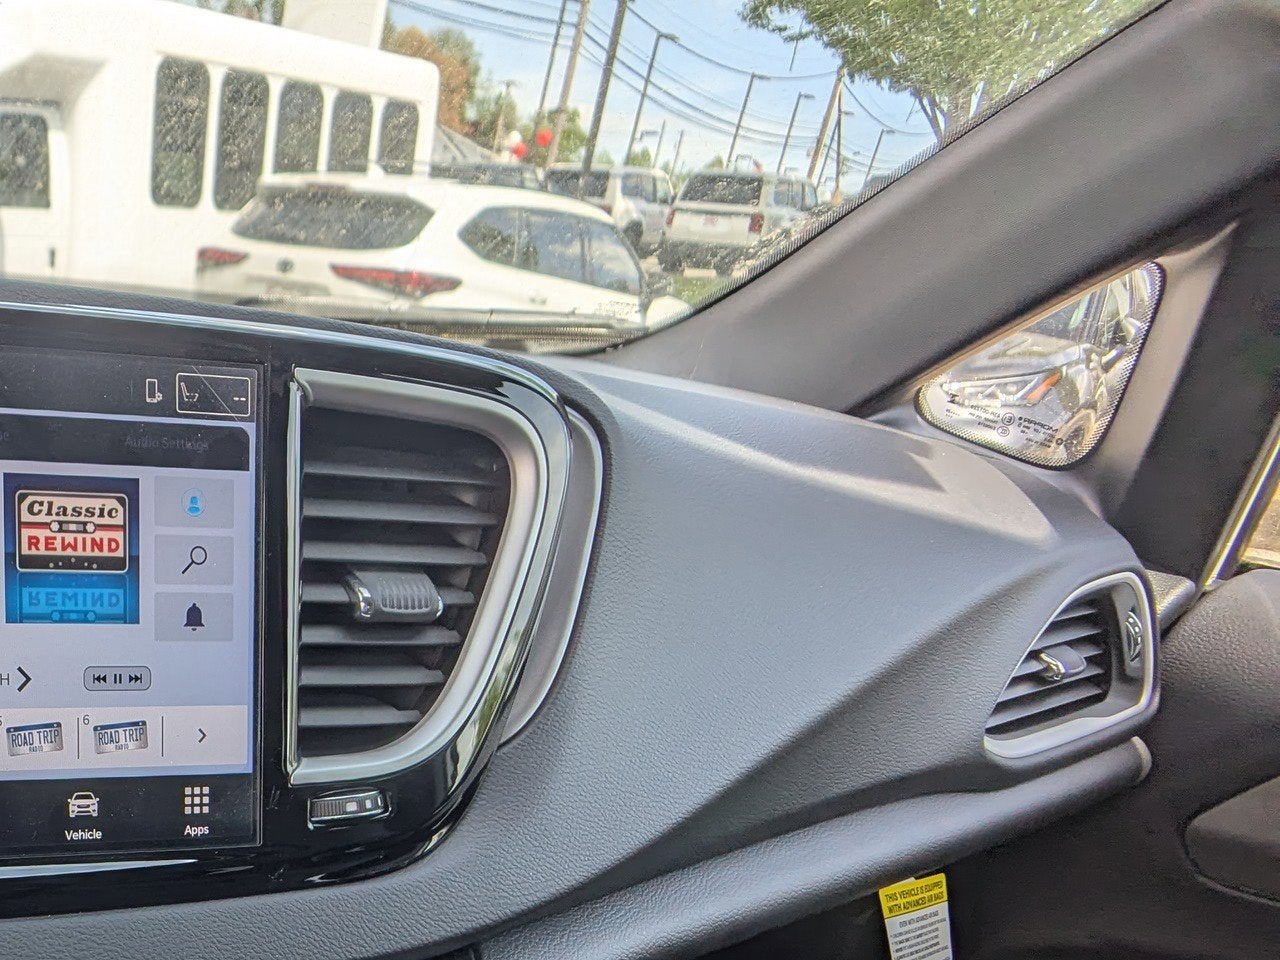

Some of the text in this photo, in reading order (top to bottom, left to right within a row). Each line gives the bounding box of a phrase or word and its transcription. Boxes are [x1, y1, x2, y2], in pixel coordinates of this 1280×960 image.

[26, 499, 120, 519] Classic
[26, 535, 121, 554] REWIND
[82, 714, 90, 725] 6
[11, 729, 60, 748] ROAD TRIP
[97, 727, 145, 746] ROAD TRIP
[64, 828, 103, 842] Vehicle
[183, 824, 210, 837] Apps
[885, 892, 898, 903] THIS
[899, 887, 919, 900] VEHICLE
[924, 880, 944, 893] EQUIPPED
[887, 903, 902, 915] WITH
[903, 895, 927, 911] ADVANCED
[933, 890, 944, 901] BAGS
